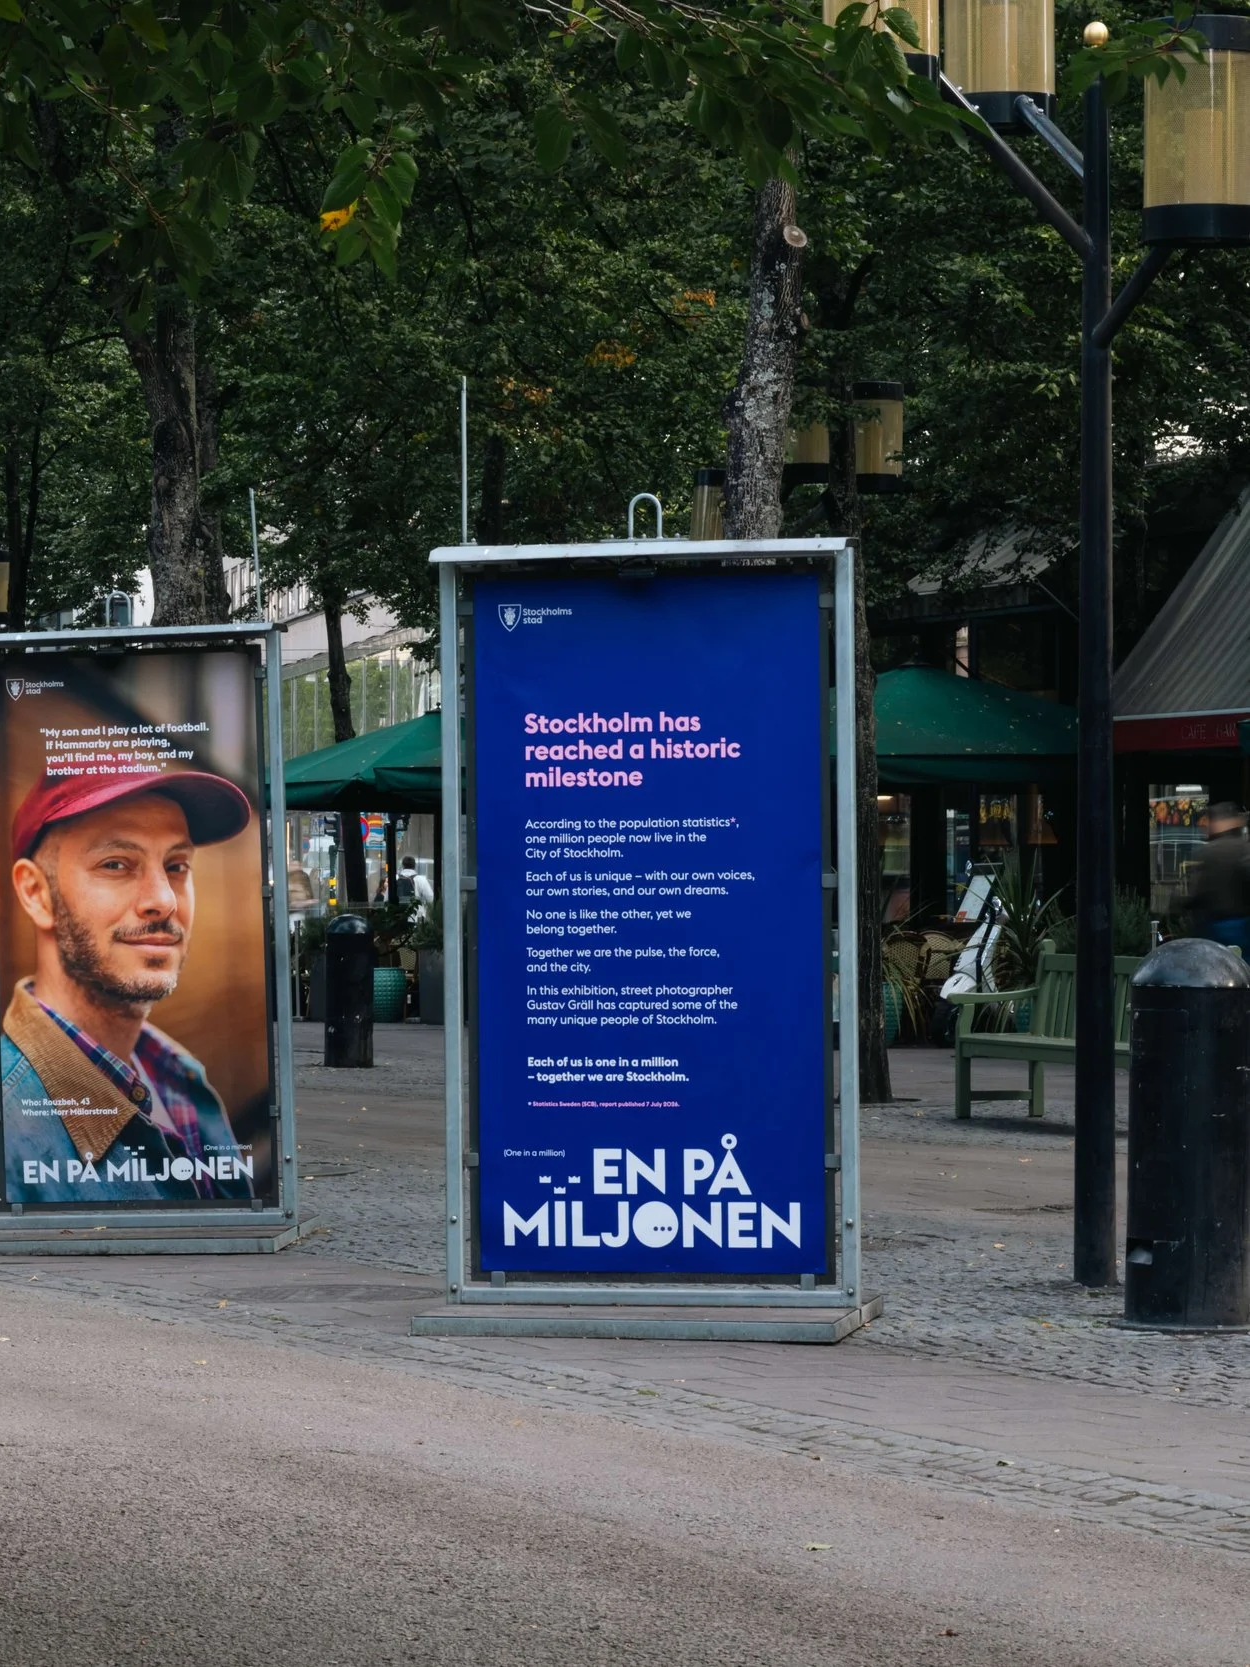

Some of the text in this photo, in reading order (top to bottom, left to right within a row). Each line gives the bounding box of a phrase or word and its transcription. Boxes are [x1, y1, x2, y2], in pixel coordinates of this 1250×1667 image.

[522, 607, 573, 616] Stockholms
[523, 616, 543, 624] stad
[81, 726, 100, 735] and
[102, 725, 106, 735] I
[108, 725, 129, 736] play
[139, 724, 153, 733] lot
[155, 724, 165, 733] of
[167, 722, 209, 732] football.
[524, 711, 701, 734] Stockholm has
[46, 741, 53, 750] If
[55, 739, 111, 750] Hammarby
[131, 738, 170, 749] playing,
[525, 737, 741, 760] reached a historic
[75, 752, 94, 761] find
[97, 754, 116, 762] me,
[118, 753, 133, 762] my
[135, 750, 155, 761] boy,
[157, 749, 176, 759] and
[178, 751, 194, 760] my
[47, 766, 85, 776] brother
[86, 766, 97, 774] at
[99, 765, 116, 774] the
[526, 767, 643, 787] milestone
[525, 819, 581, 831] According
[584, 819, 596, 828] to
[598, 818, 617, 828] the
[619, 817, 679, 830] population
[525, 836, 546, 844] one
[549, 833, 585, 843] million
[588, 833, 626, 845] people
[655, 832, 673, 842] live
[676, 832, 685, 842] in
[688, 832, 707, 842] the
[525, 847, 623, 860] City of Stockholm.
[527, 985, 733, 997] In this exhibition, street photographer
[527, 999, 738, 1012] Gustav Gräll has captured some of the
[527, 1014, 717, 1027] many unique people of Stockholm.
[528, 1056, 678, 1067] Each of us is one in a million
[536, 1071, 586, 1084] together
[626, 1071, 689, 1081] Stockholm.
[51, 1108, 69, 1116] Norr
[69, 1107, 119, 1115] Mälarstrand
[504, 1149, 522, 1157] (One
[539, 1149, 565, 1158] million)
[23, 1152, 253, 1183] EN PÅ MILJONEN
[593, 1133, 752, 1195] EN PÅ
[503, 1201, 801, 1248] MILJONEN
